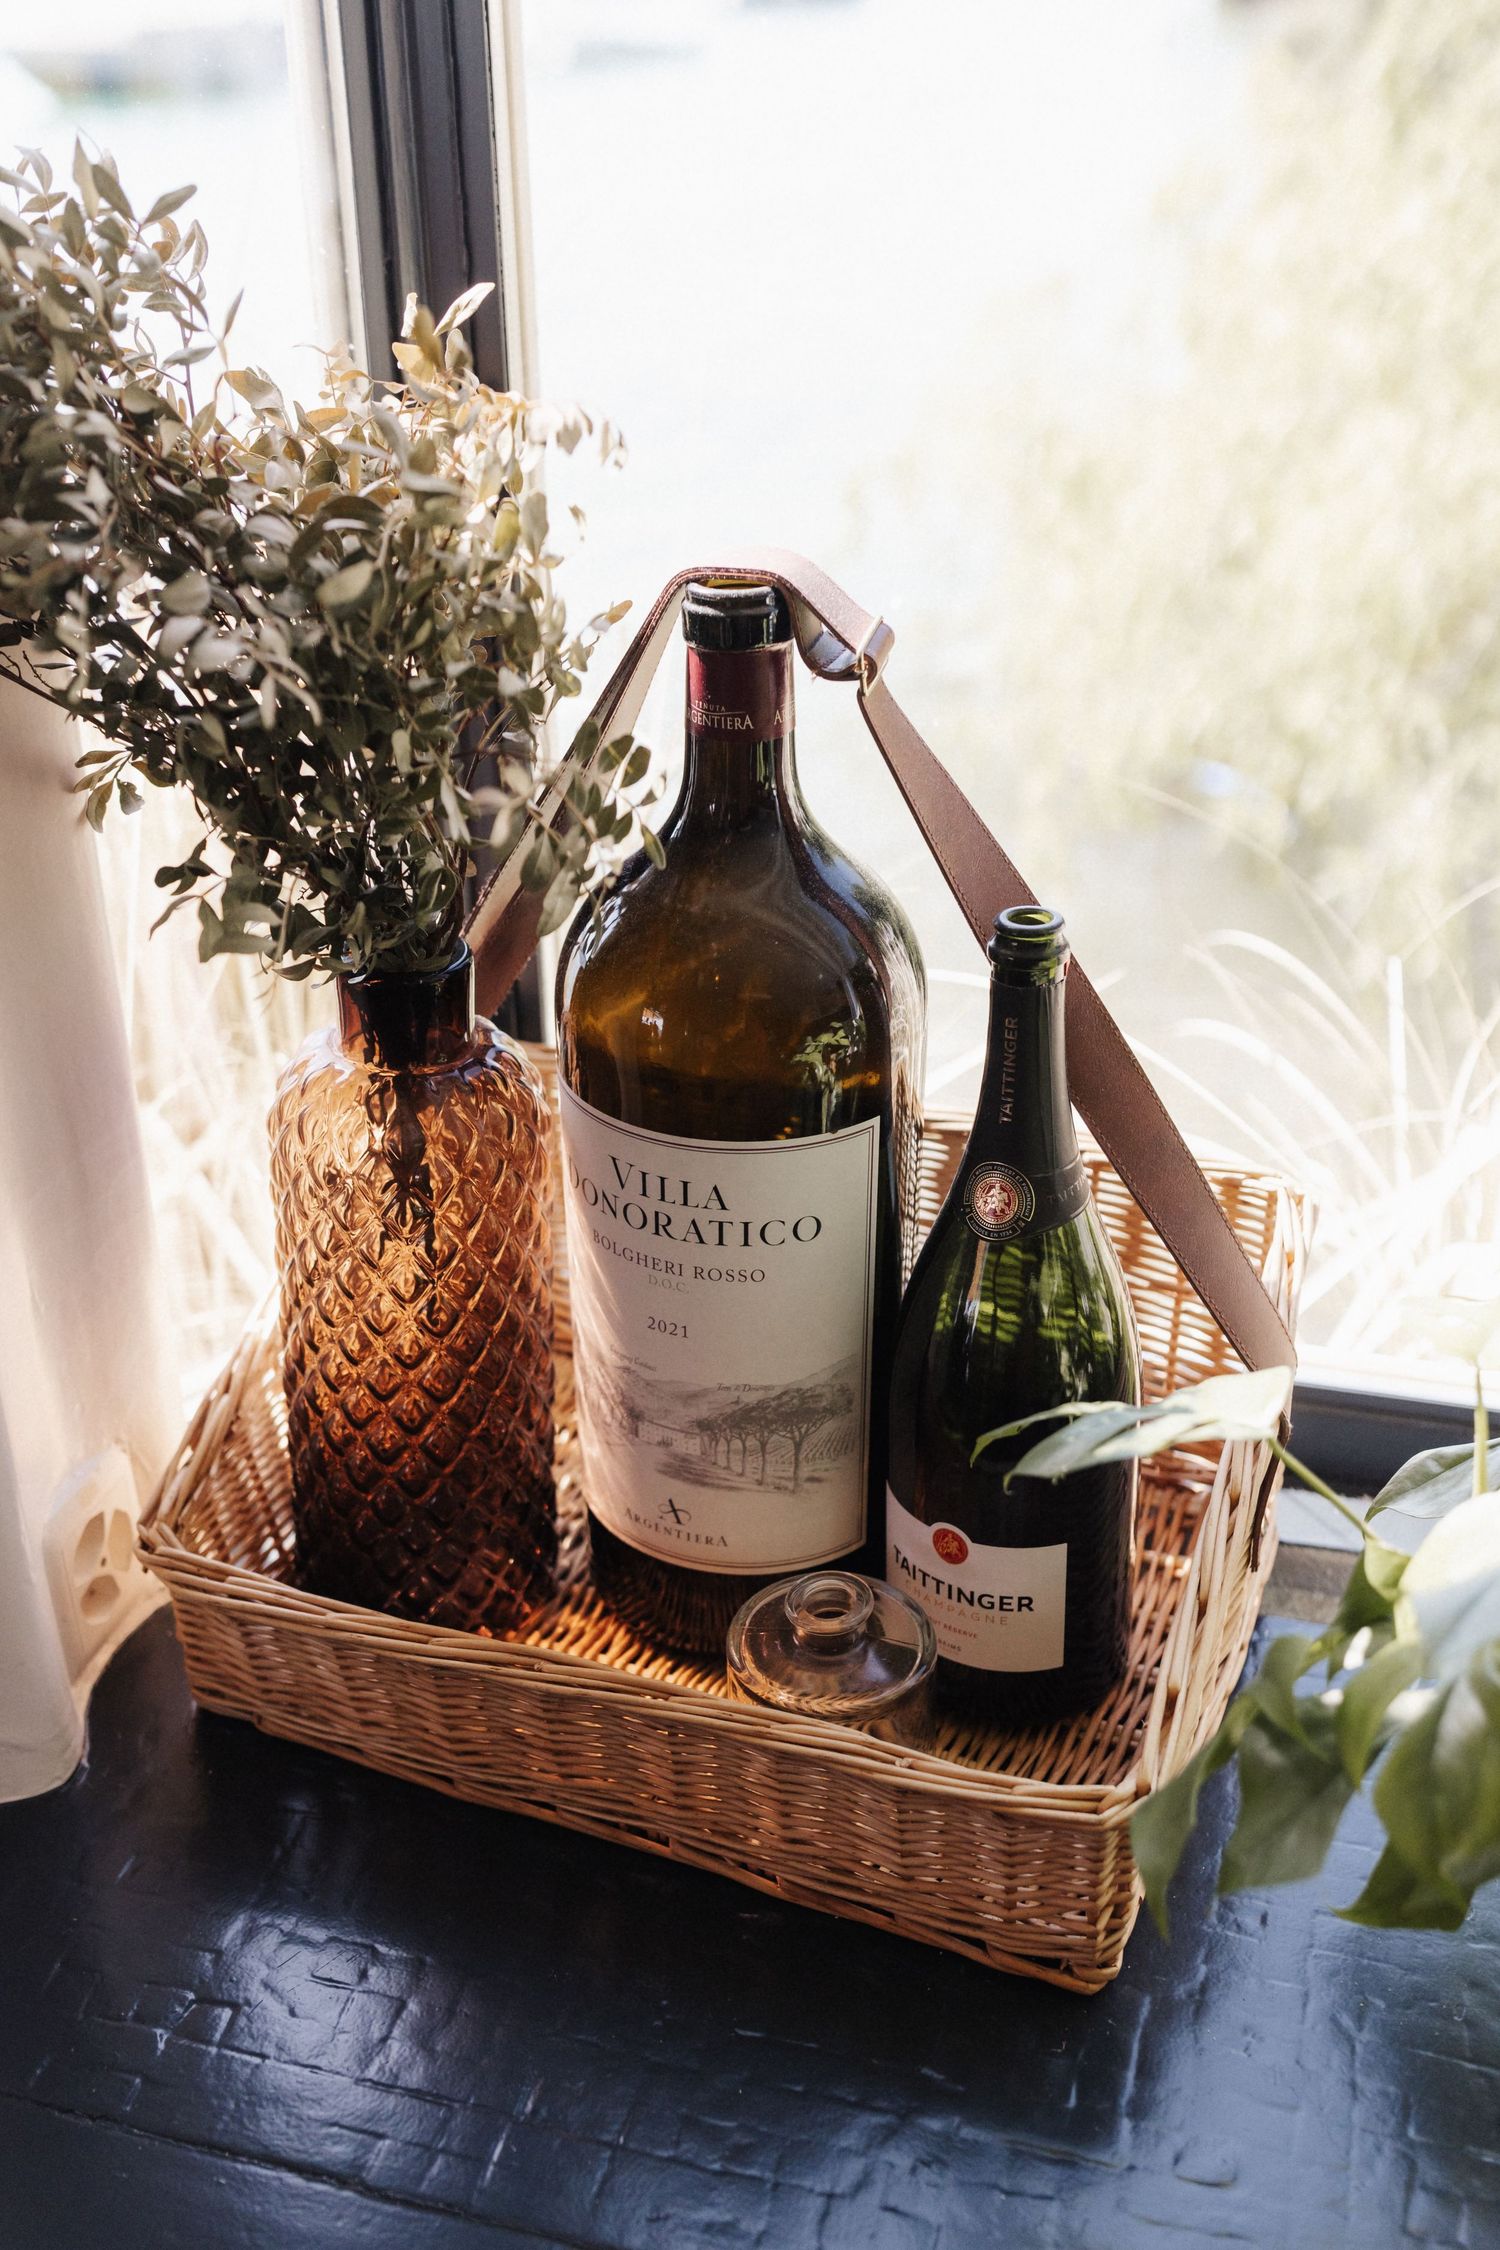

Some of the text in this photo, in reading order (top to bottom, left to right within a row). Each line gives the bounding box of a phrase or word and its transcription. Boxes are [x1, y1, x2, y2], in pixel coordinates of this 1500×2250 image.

[1000, 1016, 1018, 1124] TAITTINGER
[568, 1156, 823, 1248] DONORATICO
[607, 1154, 731, 1212] VILLA
[593, 1229, 766, 1284] BOLGHERI ROSSO
[648, 1273, 690, 1295] D.O.C.
[647, 1316, 689, 1339] 2021
[624, 1507, 729, 1548] ARGENTIERA
[892, 1544, 1035, 1613] TAITTINGER
[904, 1579, 1009, 1626] CHAMPAGNE
